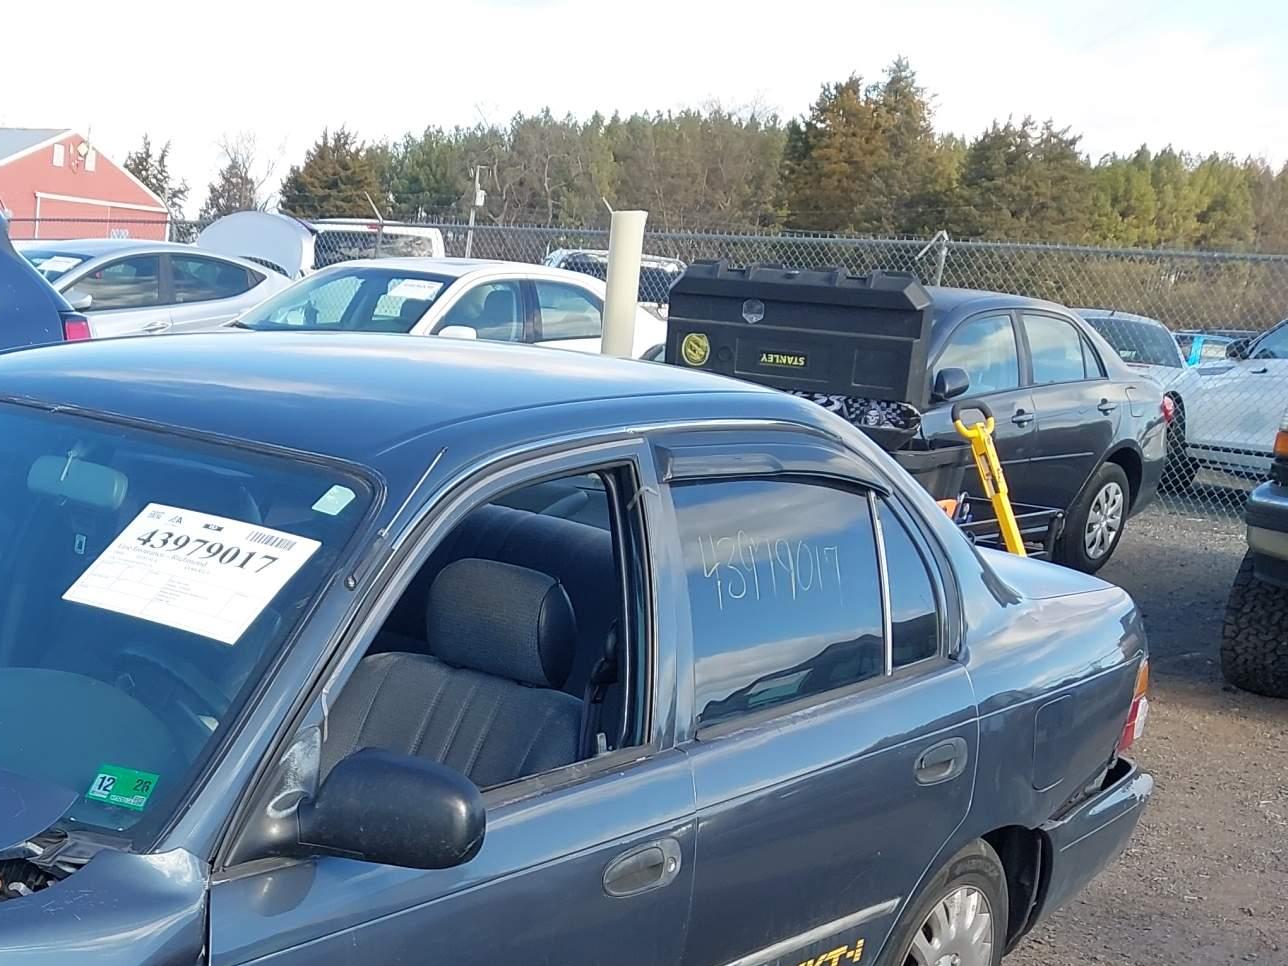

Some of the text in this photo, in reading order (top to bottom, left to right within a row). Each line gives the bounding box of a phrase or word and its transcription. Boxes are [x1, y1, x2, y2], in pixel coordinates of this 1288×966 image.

[760, 353, 806, 367] STANLEY
[136, 527, 280, 574] 43979017
[697, 529, 844, 611] 43979017
[97, 775, 116, 791] 12
[132, 779, 152, 793] 26
